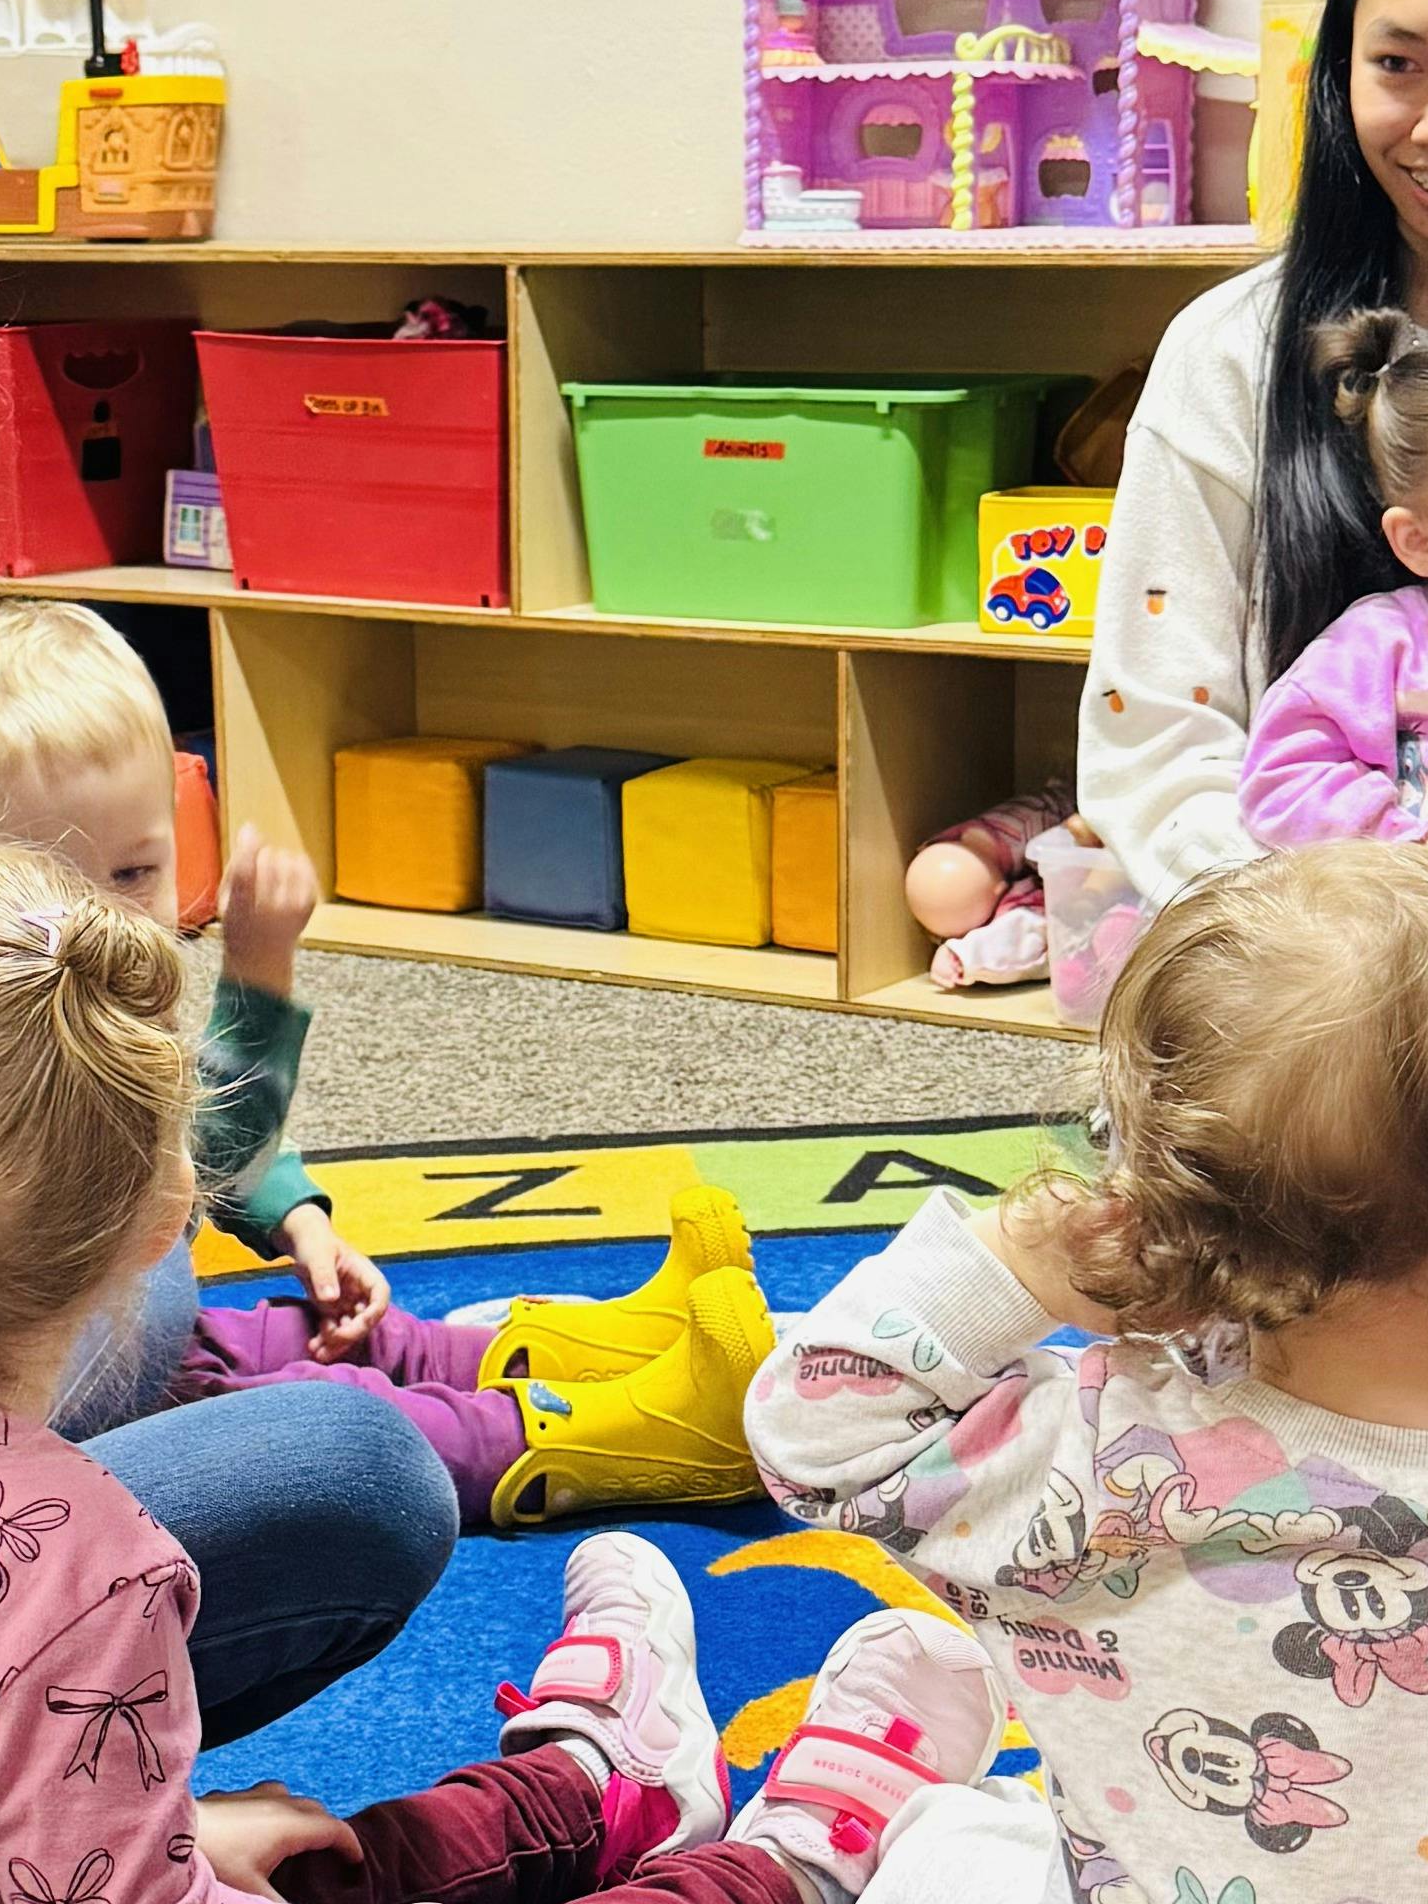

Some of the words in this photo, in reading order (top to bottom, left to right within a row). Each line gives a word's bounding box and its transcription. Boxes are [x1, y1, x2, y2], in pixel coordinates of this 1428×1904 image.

[1010, 526, 1075, 560] TOY
[822, 1149, 1002, 1204] A
[996, 1615, 1084, 1651] Daisy
[1019, 1647, 1122, 1682] Minnie
